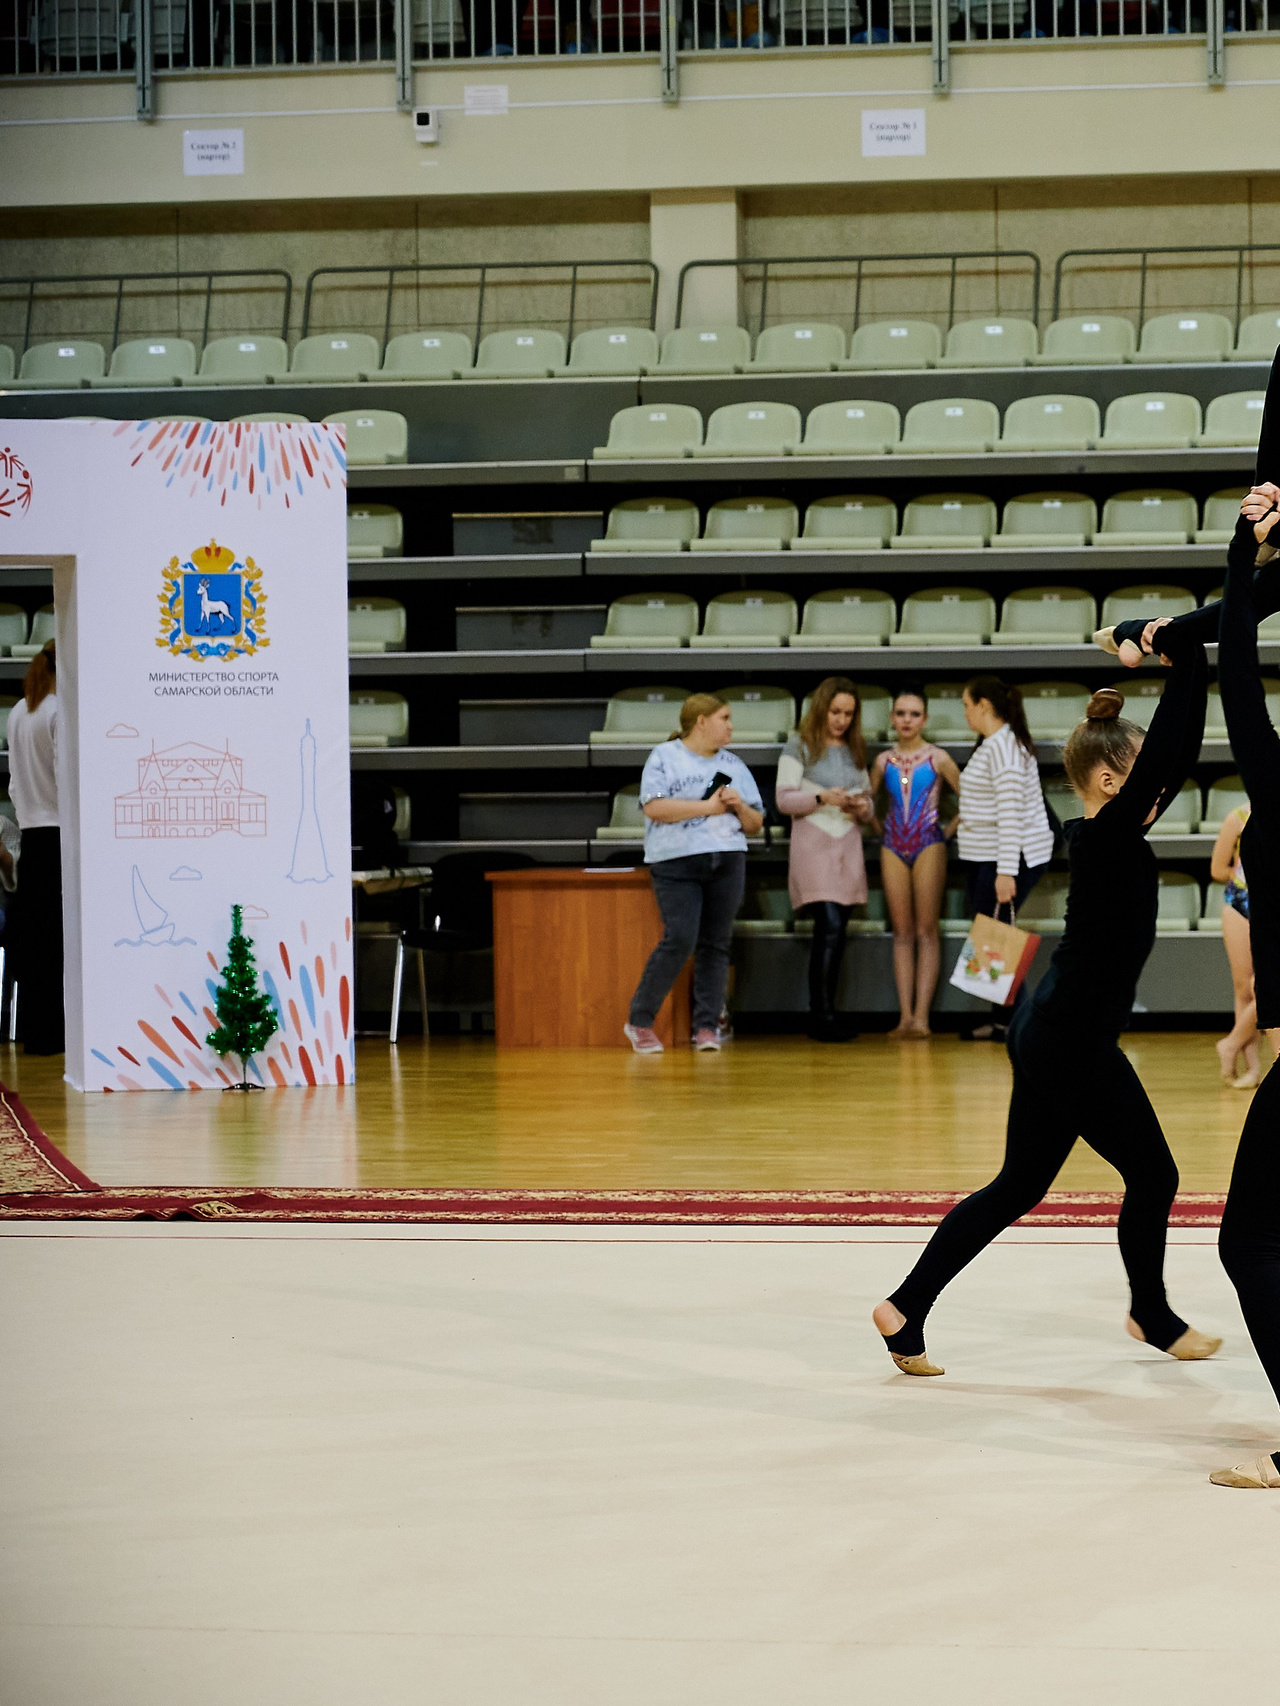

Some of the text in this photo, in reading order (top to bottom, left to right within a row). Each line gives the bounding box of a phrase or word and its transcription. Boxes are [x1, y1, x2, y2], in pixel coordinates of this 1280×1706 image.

[148, 672, 280, 682] МИНИСТЕРСТВО СПОРТА
[154, 685, 274, 696] САМАРСКОЙ ОБЛАСТИ
